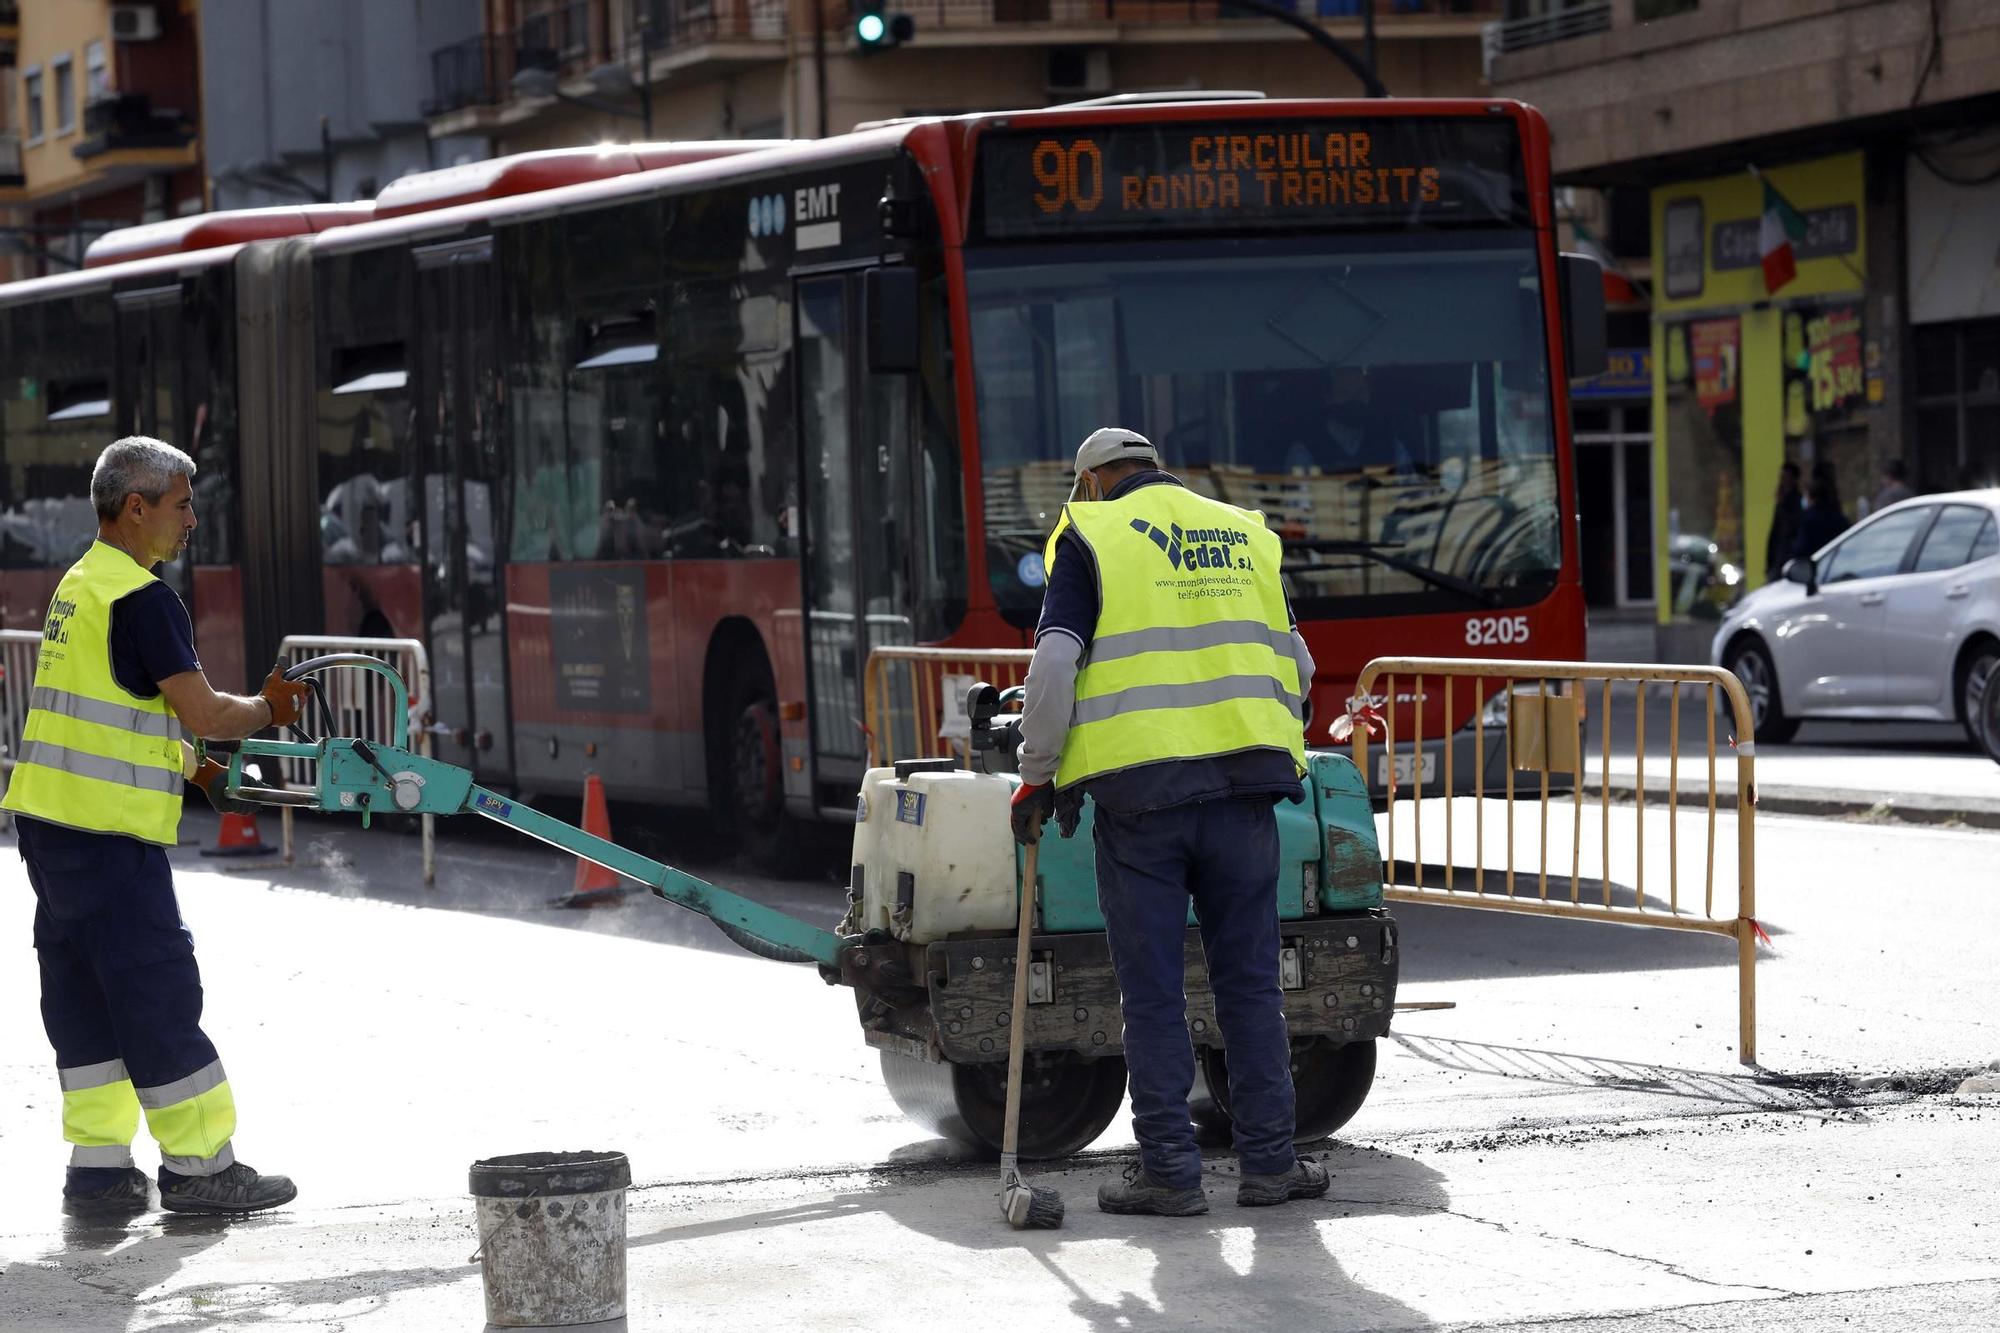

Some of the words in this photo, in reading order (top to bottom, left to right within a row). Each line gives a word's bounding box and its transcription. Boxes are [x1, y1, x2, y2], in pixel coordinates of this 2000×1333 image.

[1190, 132, 1371, 170] CIRCULAR
[1032, 139, 1104, 214] 90
[1122, 174, 1240, 210] RONDA
[1256, 168, 1440, 206] TRANSITS
[795, 183, 840, 221] EMT
[1185, 527, 1249, 546] montajes
[1465, 615, 1530, 646] 8205
